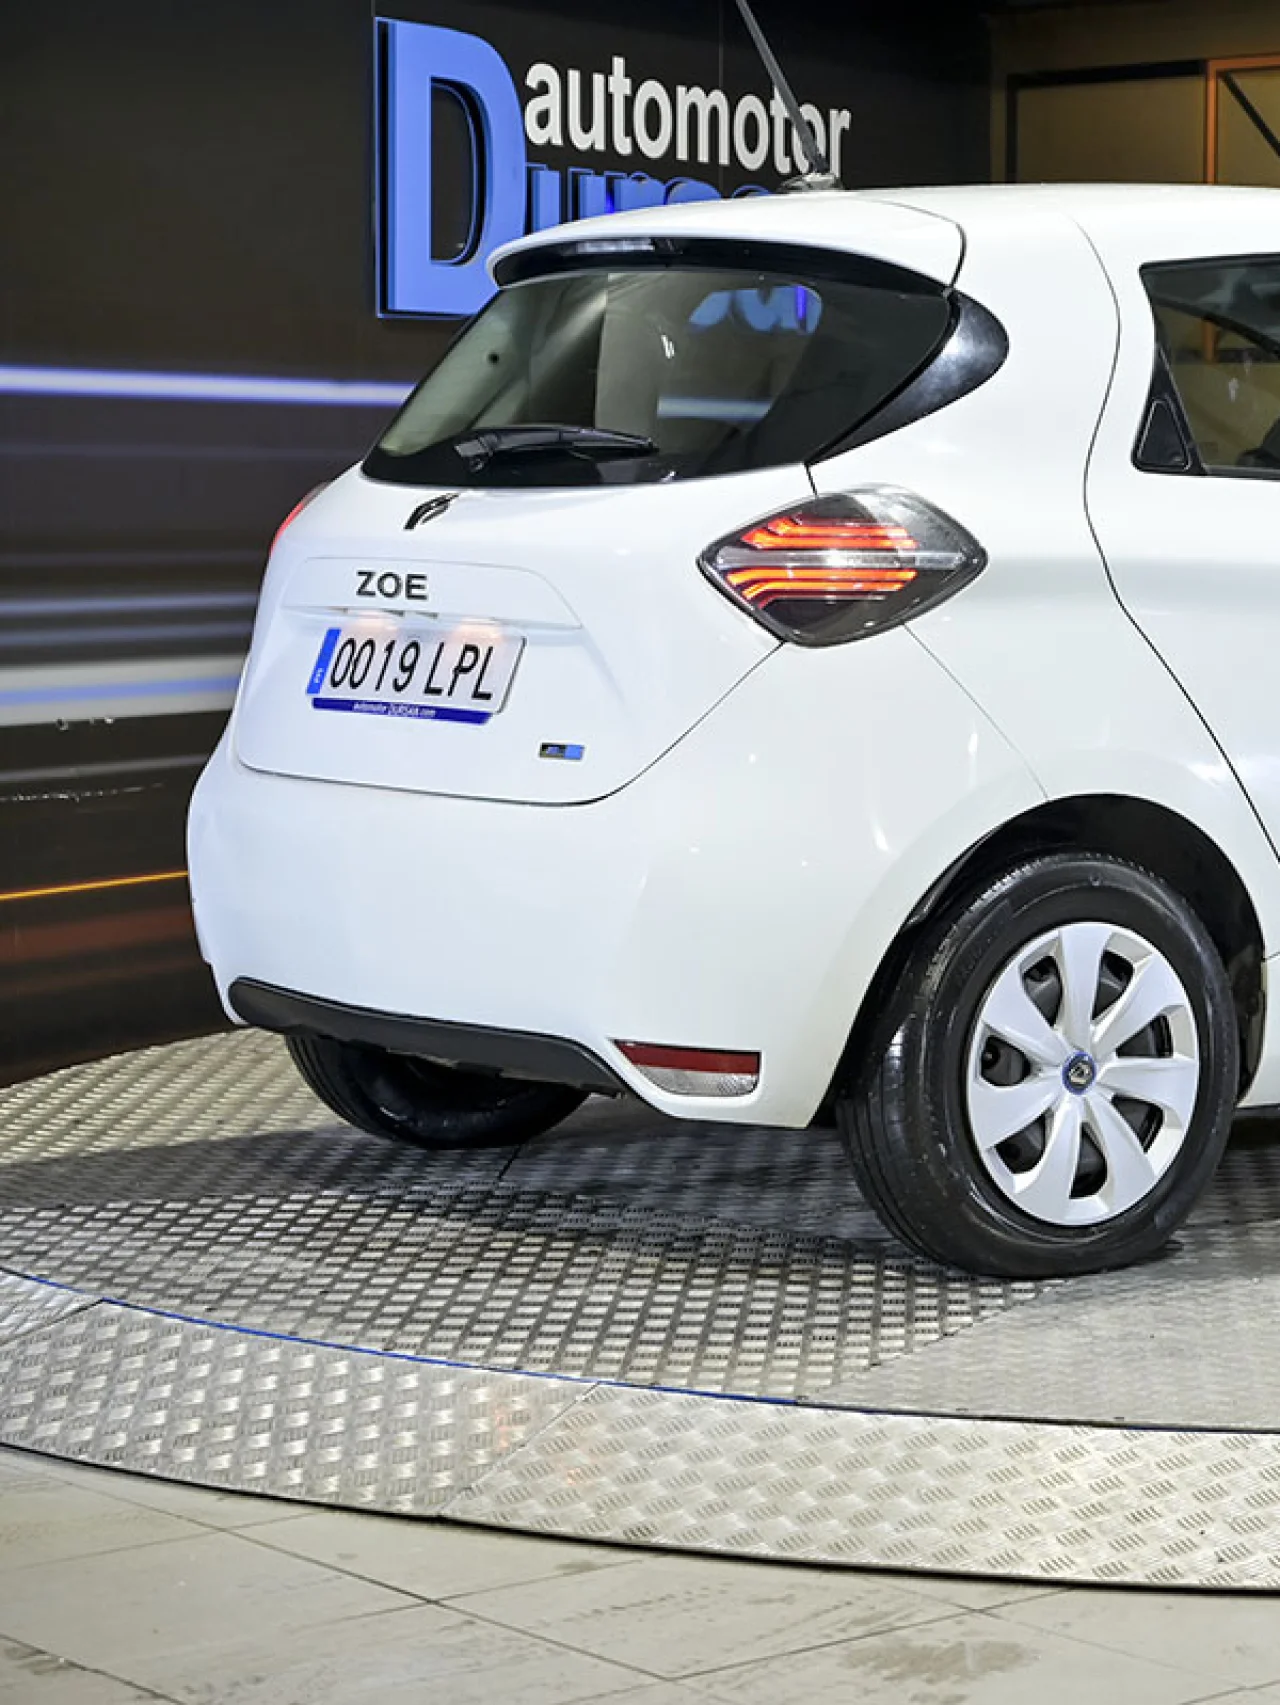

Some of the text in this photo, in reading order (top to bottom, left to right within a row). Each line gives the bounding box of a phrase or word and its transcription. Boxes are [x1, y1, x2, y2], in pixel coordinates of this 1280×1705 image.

[524, 55, 852, 178] automotor
[355, 570, 429, 601] ZOE
[330, 638, 494, 700] 0019 LPL
